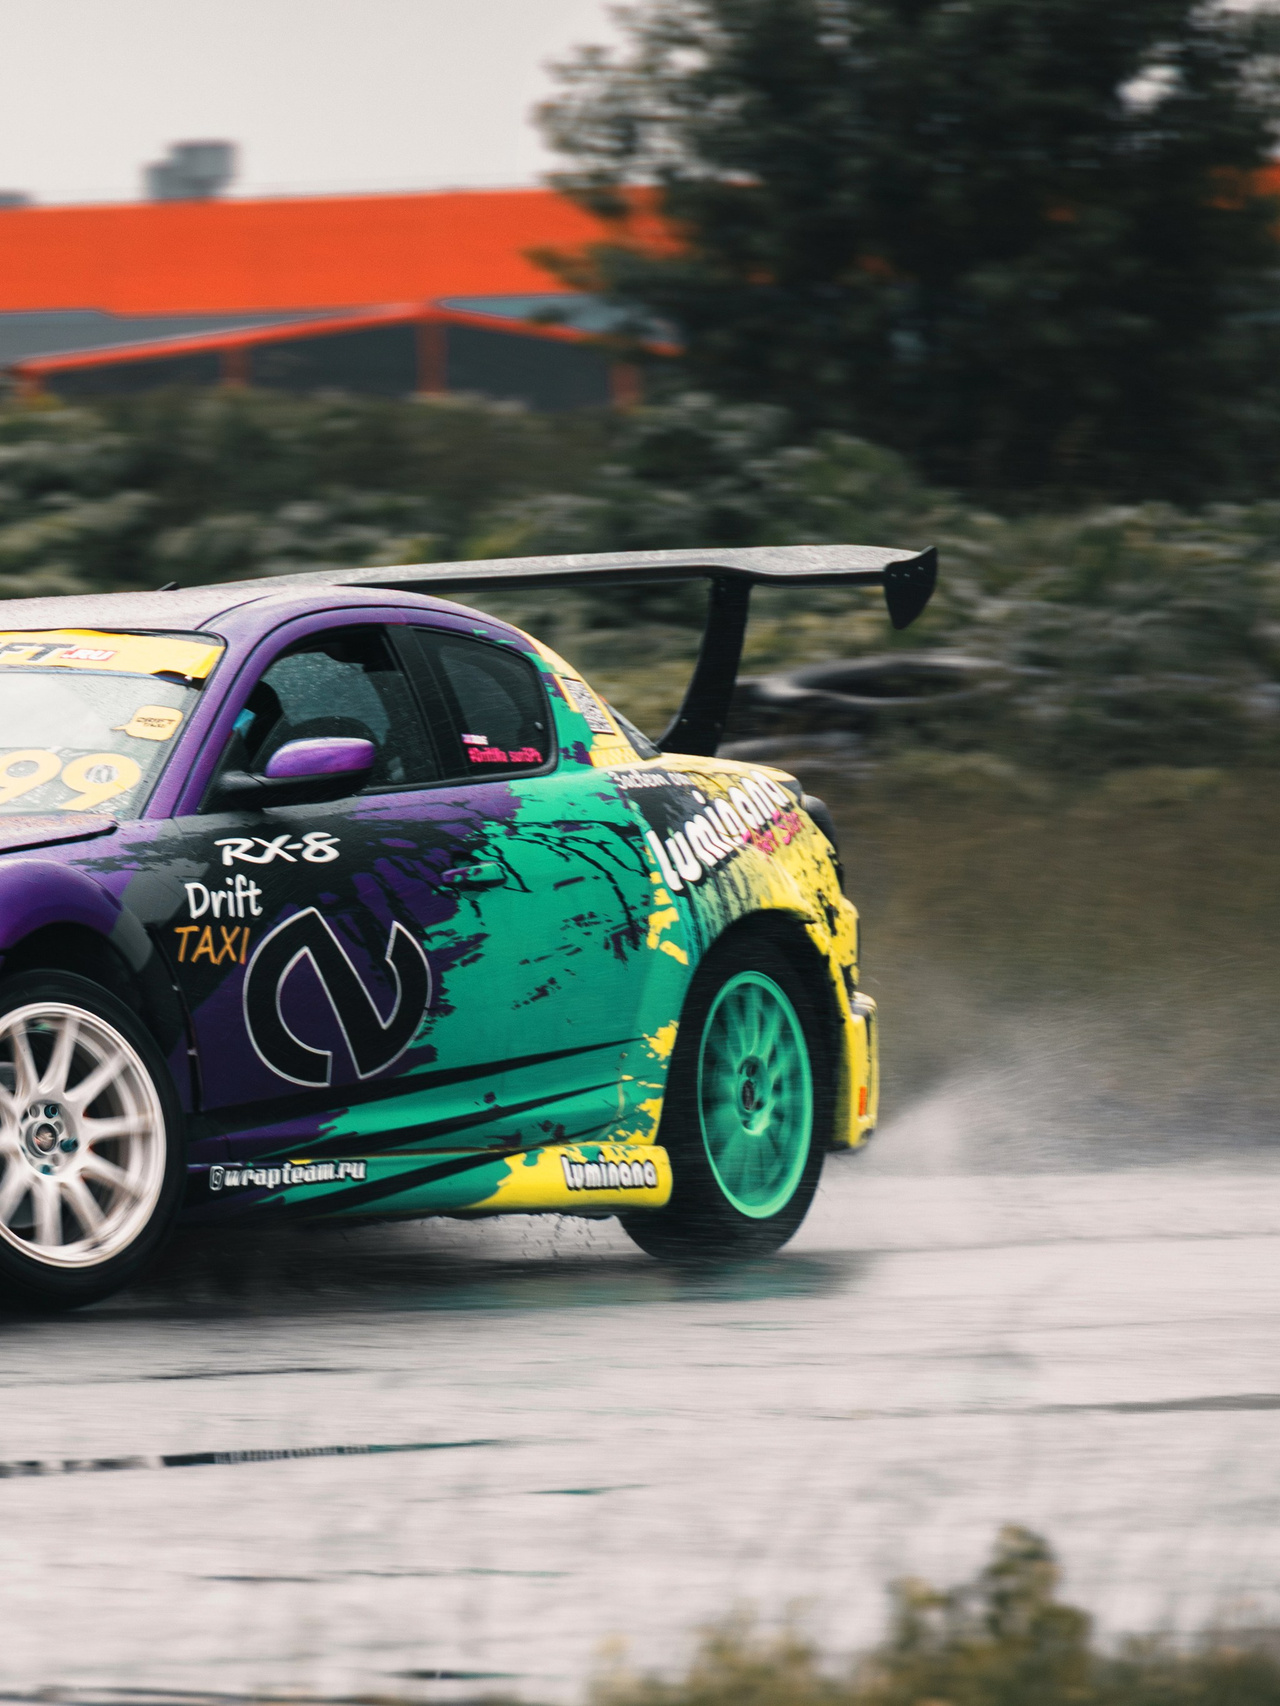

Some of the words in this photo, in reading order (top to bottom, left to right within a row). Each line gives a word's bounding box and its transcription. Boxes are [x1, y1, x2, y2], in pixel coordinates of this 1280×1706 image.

[214, 831, 341, 866] RX-8
[185, 874, 263, 919] Drift
[174, 925, 250, 965] TAXI
